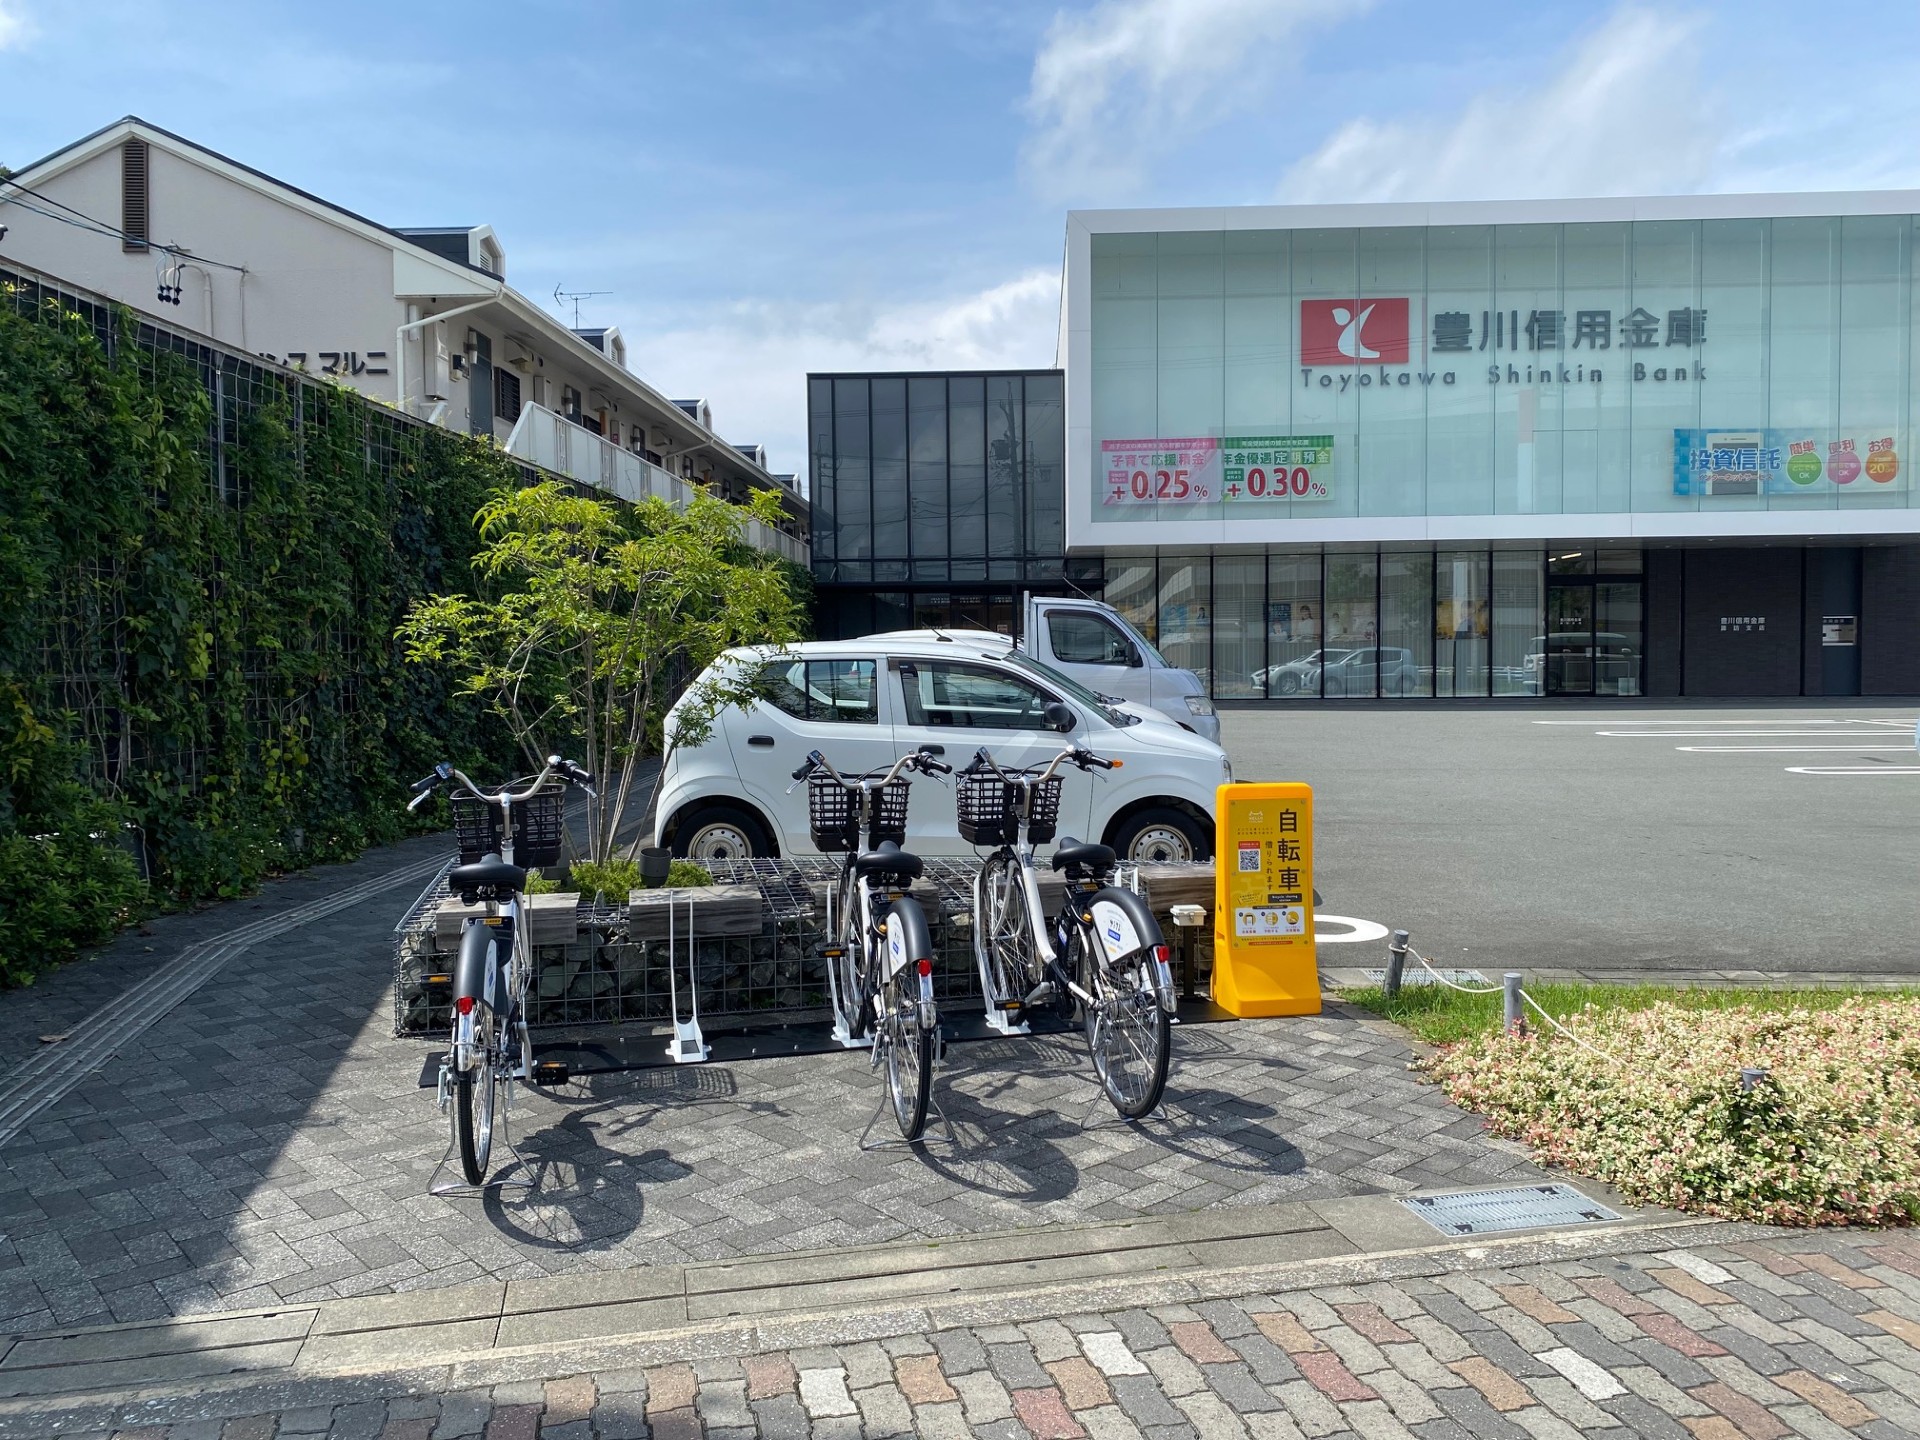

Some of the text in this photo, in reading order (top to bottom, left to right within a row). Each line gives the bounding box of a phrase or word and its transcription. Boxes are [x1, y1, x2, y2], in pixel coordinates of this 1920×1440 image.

[1432, 306, 1707, 352] 豊川信用金庫
[1301, 361, 1707, 393] Toyokawa Shinkin Bank
[1789, 439, 1816, 455] 簡単
[1828, 438, 1855, 454] 便利
[1868, 437, 1894, 452] お得
[1690, 447, 1782, 472] 投資信託
[1720, 616, 1766, 624] 豊川信用金庫
[1277, 808, 1300, 891] 自転車
[1265, 840, 1273, 891] 借りられます
